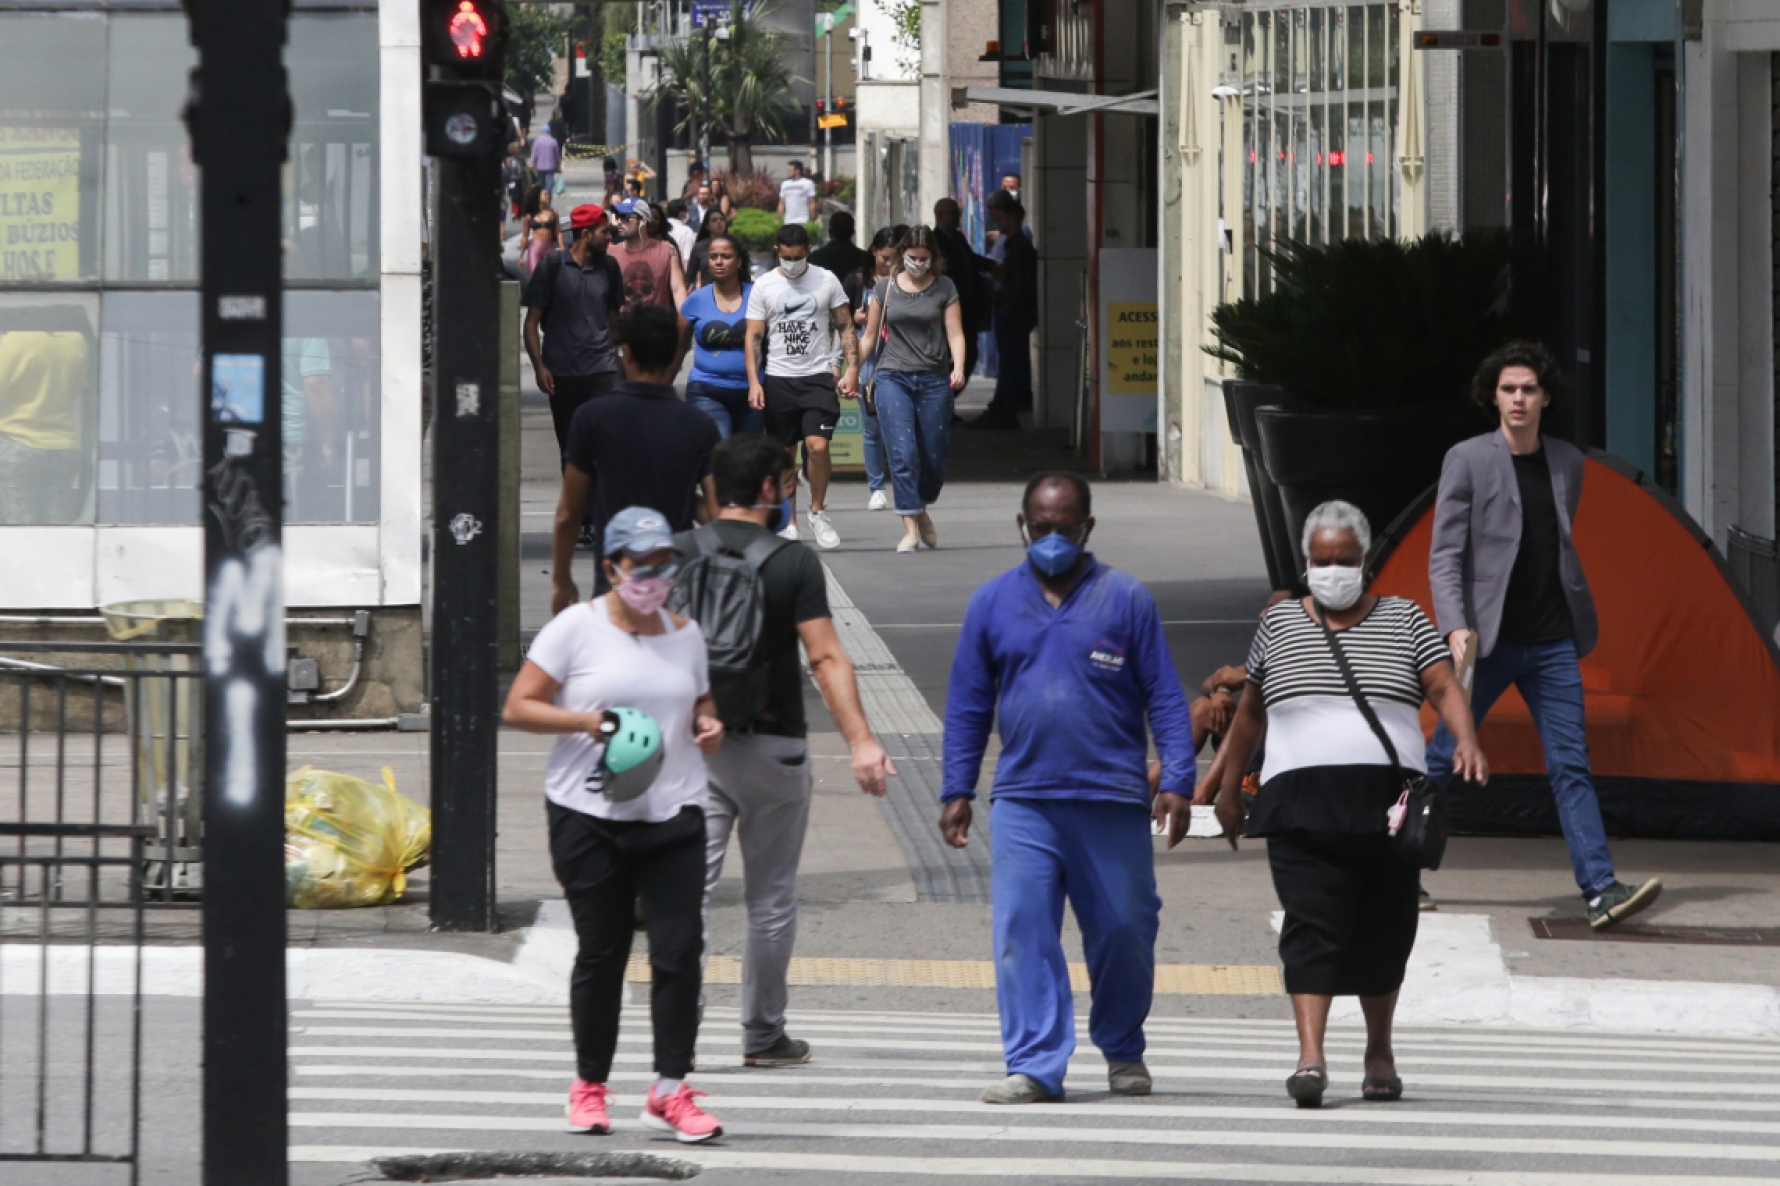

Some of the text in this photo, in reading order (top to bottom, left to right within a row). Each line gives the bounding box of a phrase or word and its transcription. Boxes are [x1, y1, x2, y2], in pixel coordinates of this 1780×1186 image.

[778, 321, 819, 333] HAVE A
[784, 331, 810, 344] NIKE
[1111, 339, 1133, 349] aos
[1132, 356, 1140, 366] e
